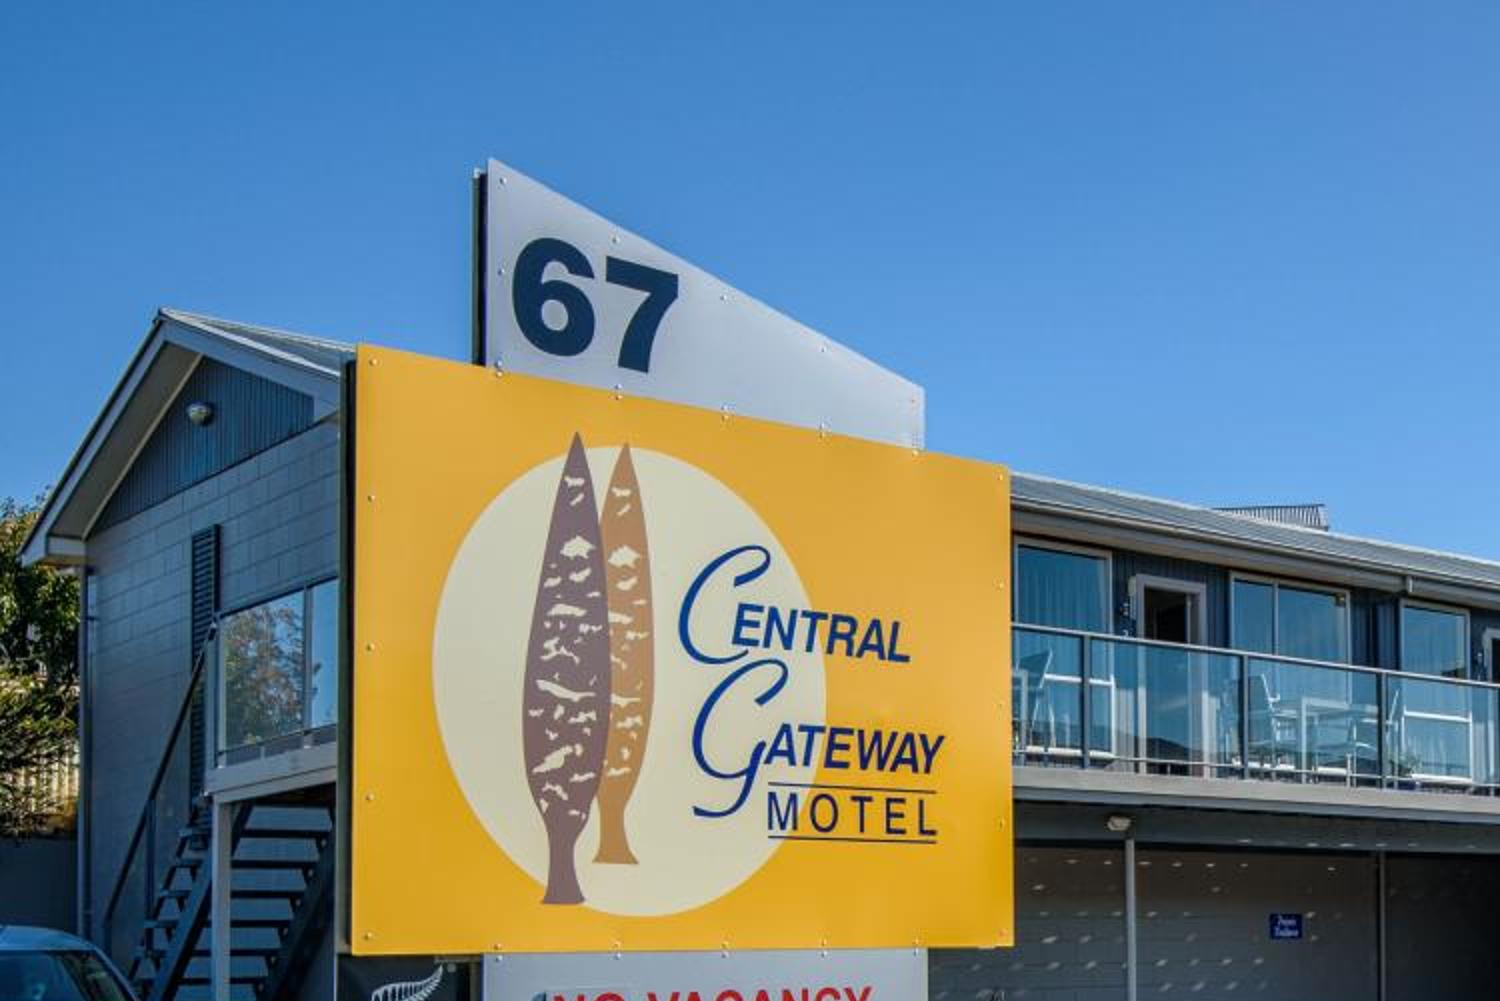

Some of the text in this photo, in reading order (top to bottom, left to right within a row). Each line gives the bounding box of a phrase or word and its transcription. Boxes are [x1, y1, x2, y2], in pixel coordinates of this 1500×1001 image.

[511, 236, 680, 374] 67
[678, 545, 911, 664] CENTRAL
[690, 659, 945, 818] GATEWAY
[767, 790, 938, 837] MOTEL
